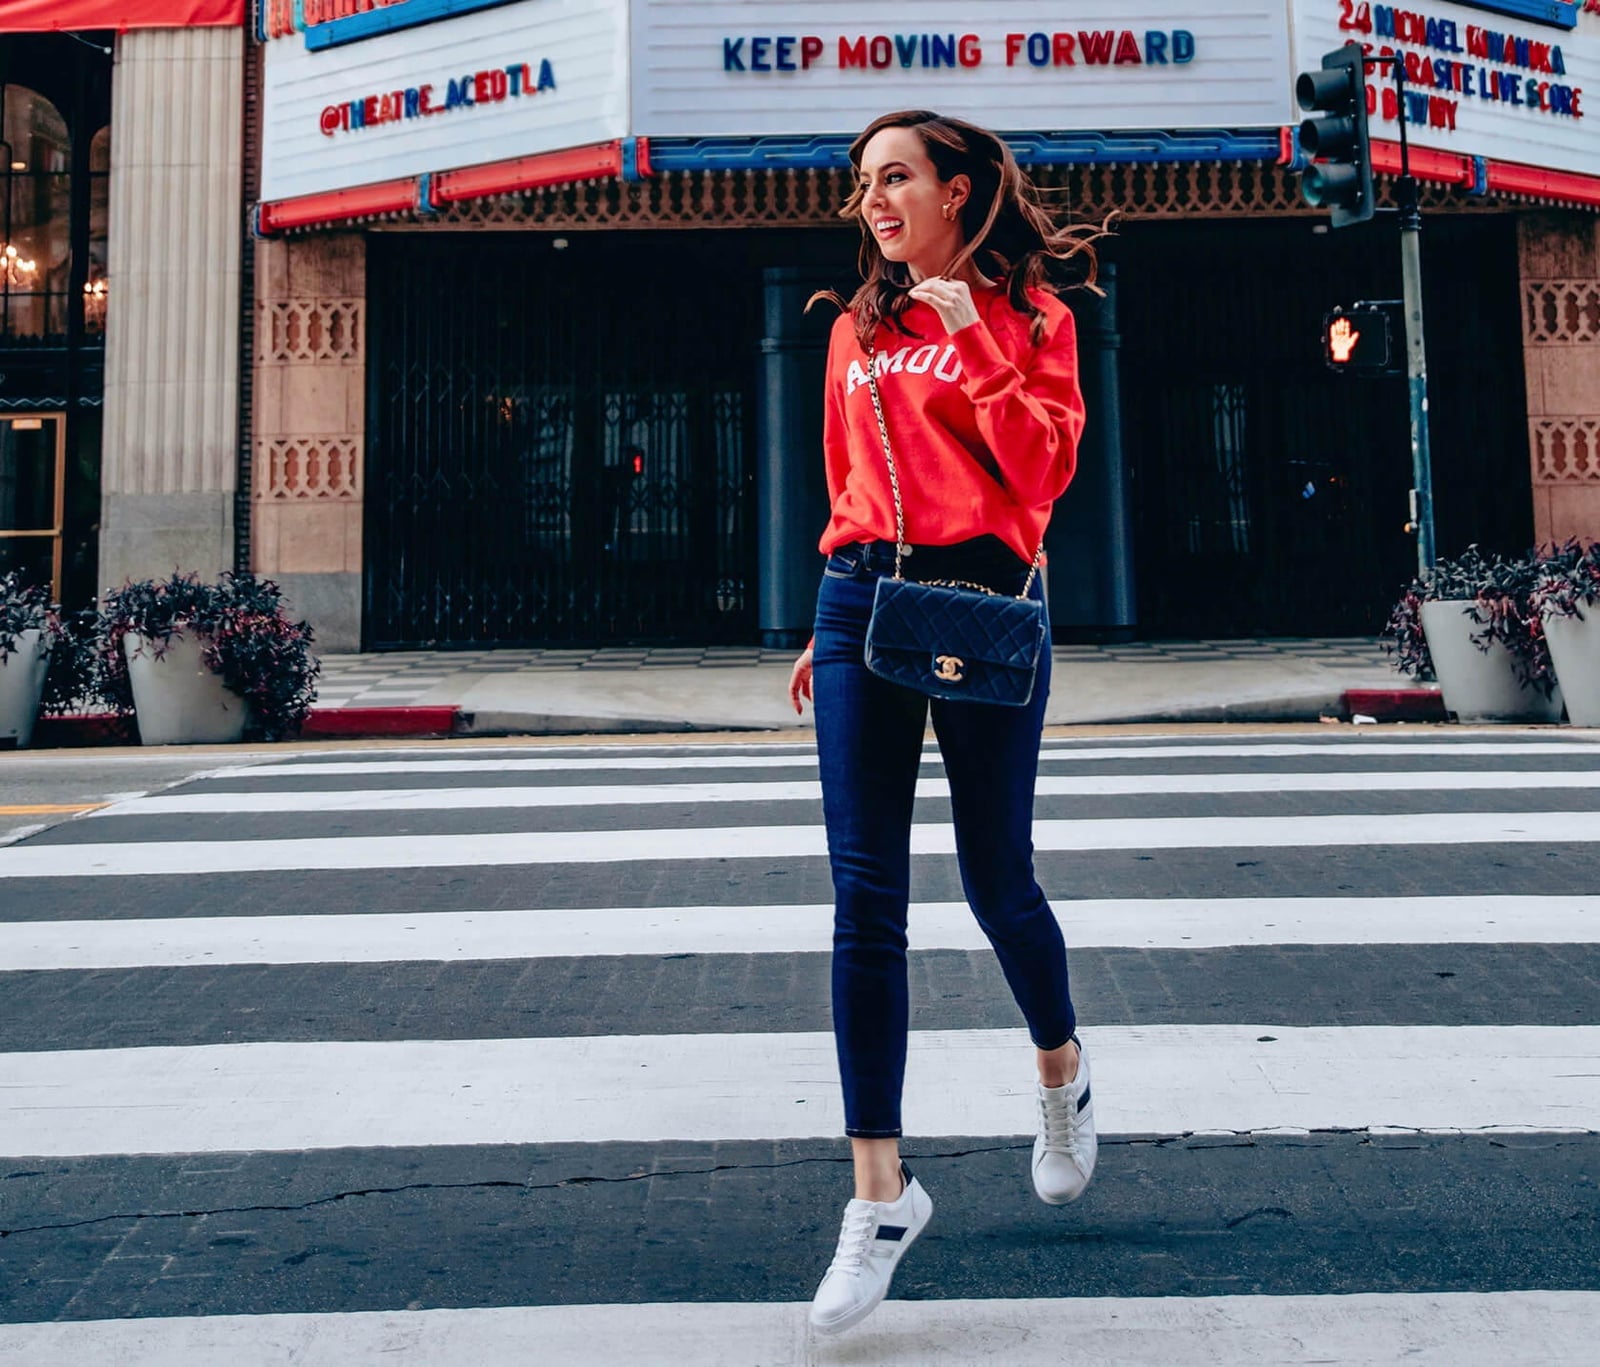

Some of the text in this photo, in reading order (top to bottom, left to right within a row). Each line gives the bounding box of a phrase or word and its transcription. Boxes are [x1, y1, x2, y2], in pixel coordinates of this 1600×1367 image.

[723, 30, 1195, 72] KEEP MOVING FORWARD
[1338, 0, 1372, 34] 24
[1374, 4, 1464, 53] MICHAEL
[319, 58, 556, 137] @THEATRE_ACEDTLA
[1379, 45, 1476, 96] PARASITE
[1479, 67, 1524, 105] LIVE
[1526, 78, 1583, 118] SCORE
[846, 344, 964, 396] AMOU
